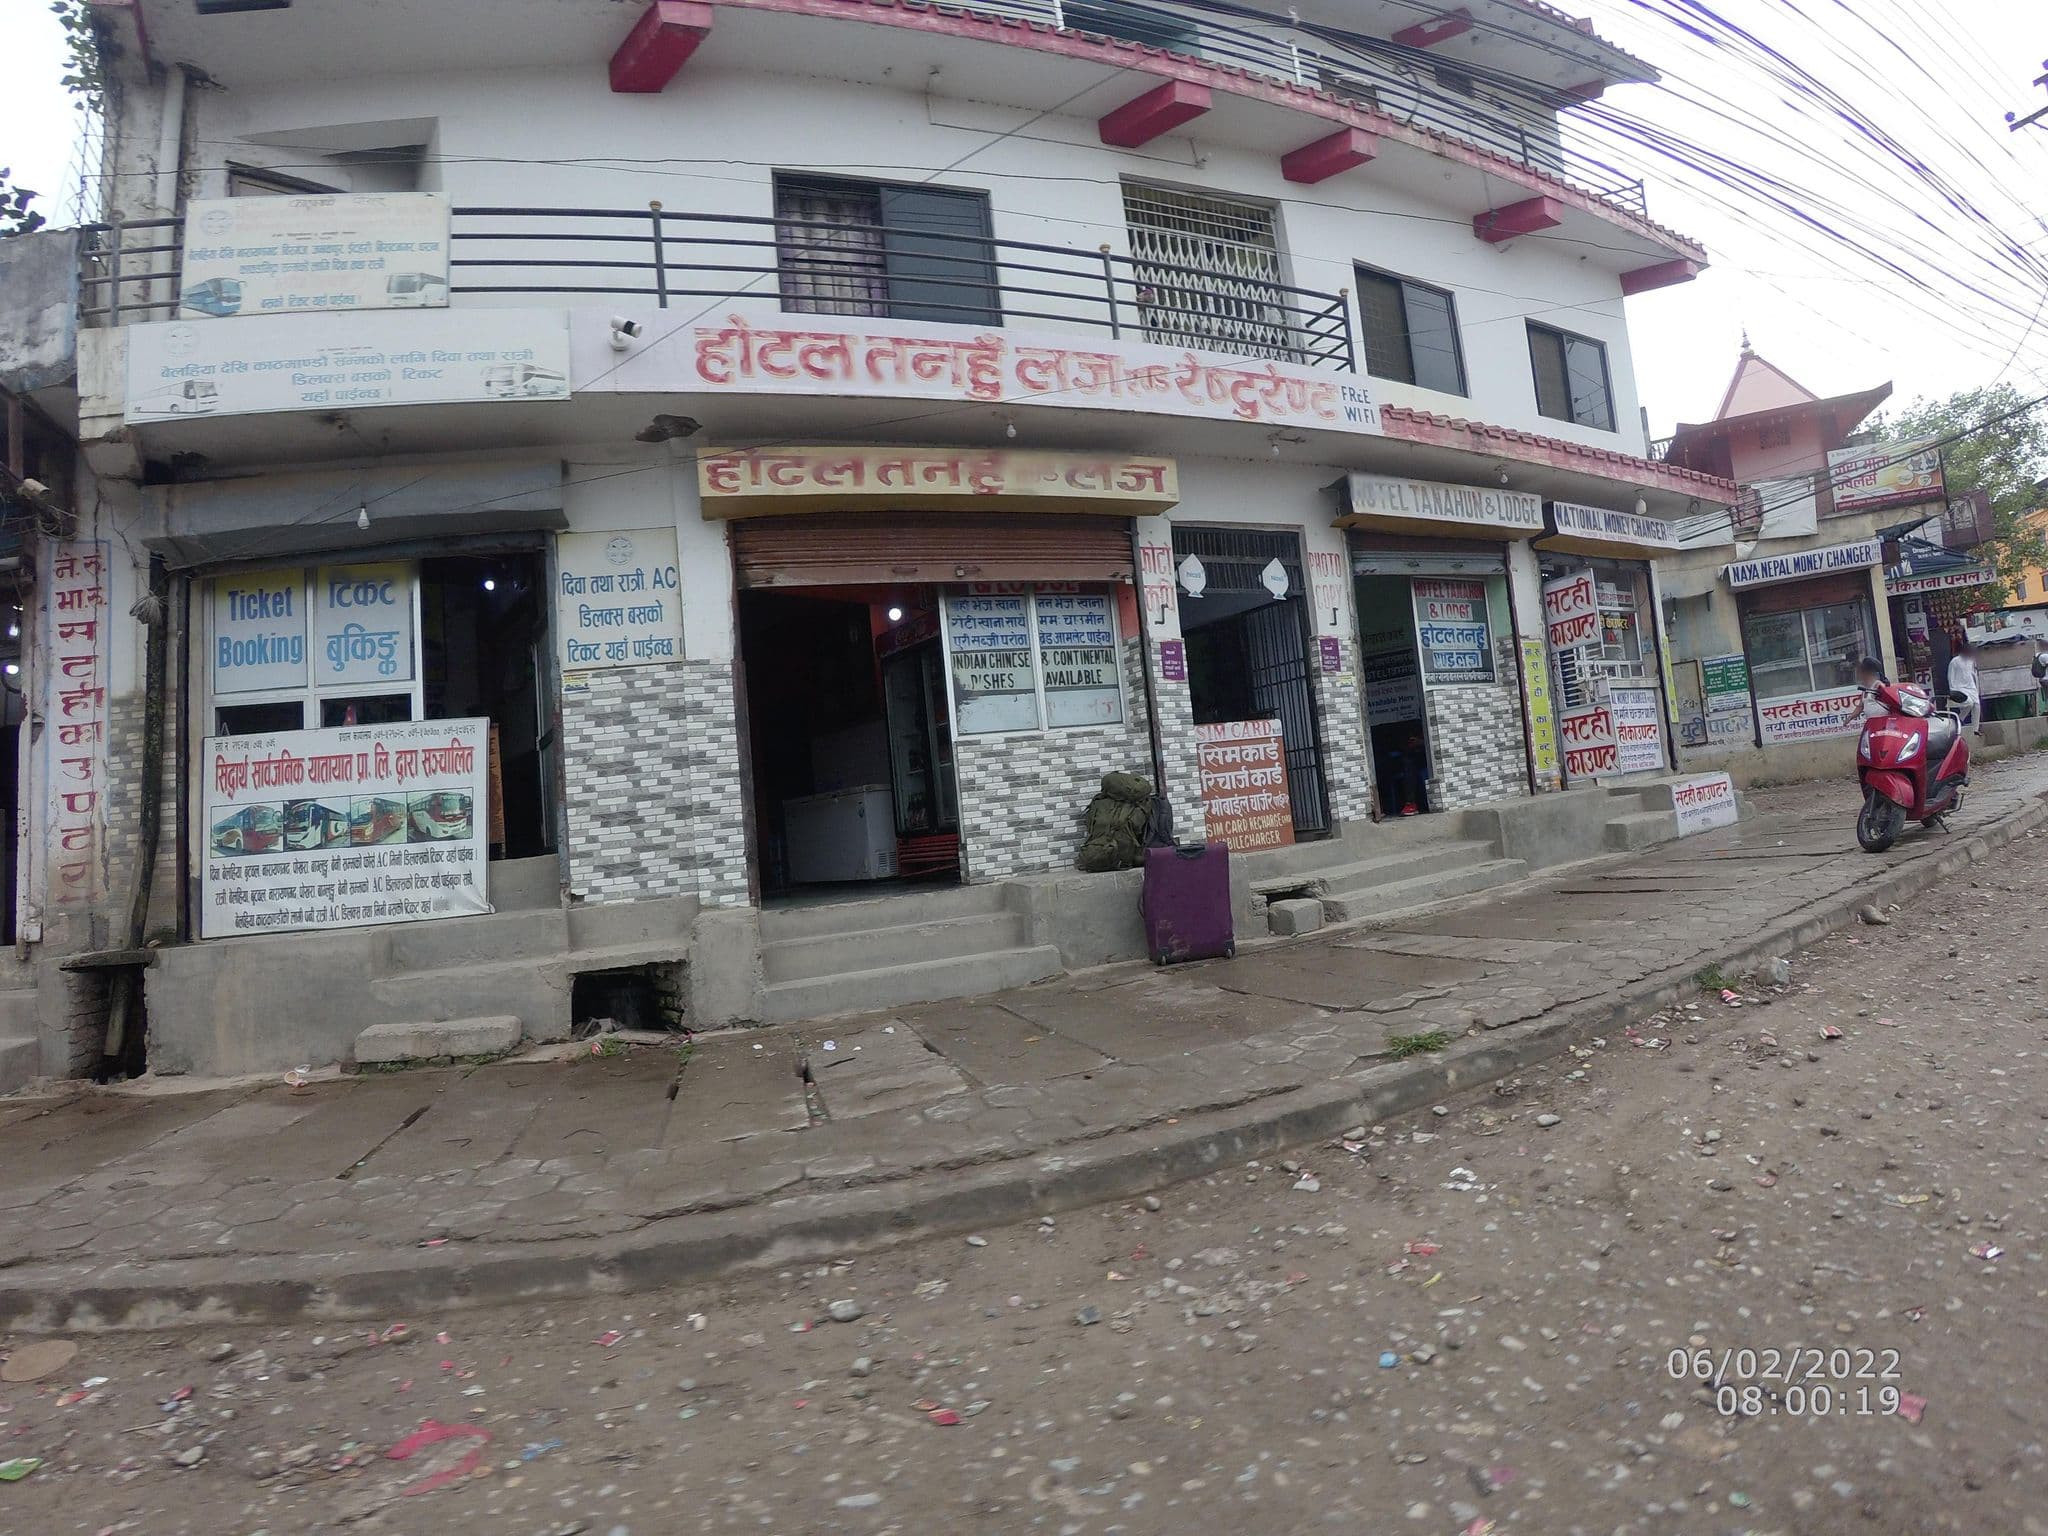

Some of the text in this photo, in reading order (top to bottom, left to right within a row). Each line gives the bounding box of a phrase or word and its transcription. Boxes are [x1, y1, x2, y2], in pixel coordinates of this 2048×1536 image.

[695, 313, 857, 385] होटल
[1015, 346, 1122, 396] लज
[1340, 385, 1372, 405] FREE
[1408, 484, 1485, 519] TANAHUN
[1485, 497, 1497, 516] &
[1496, 494, 1539, 525] LODGE
[1555, 503, 1603, 532] NATIONAL
[1603, 512, 1631, 536] MONEY
[1631, 517, 1667, 541] CHANGER
[1307, 551, 1342, 578] PHOTO
[1732, 561, 1761, 583] NAYA
[1760, 557, 1793, 579] NEPAL
[1792, 551, 1824, 573] MONEY
[1826, 544, 1873, 568] CHANGER
[561, 571, 587, 597] दिवा
[590, 575, 614, 595] तथा
[652, 566, 677, 590] AC
[228, 586, 293, 621] Ticket
[1429, 602, 1439, 619] &
[1546, 577, 1591, 617] सटही
[578, 599, 664, 628] डिलक्स बसको
[1420, 622, 1455, 649] होटल
[218, 632, 304, 669] Booking
[567, 638, 601, 663] टिकट
[1053, 649, 1116, 667] CONTINENTAL
[1045, 669, 1104, 687] AVAILABLE
[1761, 699, 1808, 720] सटही
[1196, 723, 1226, 742] SIM
[1230, 719, 1272, 739] CARD
[1562, 706, 1610, 744] सटही
[251, 749, 305, 791] सार्वजनिक
[308, 753, 354, 784] यातायात
[1206, 821, 1224, 839] SIM
